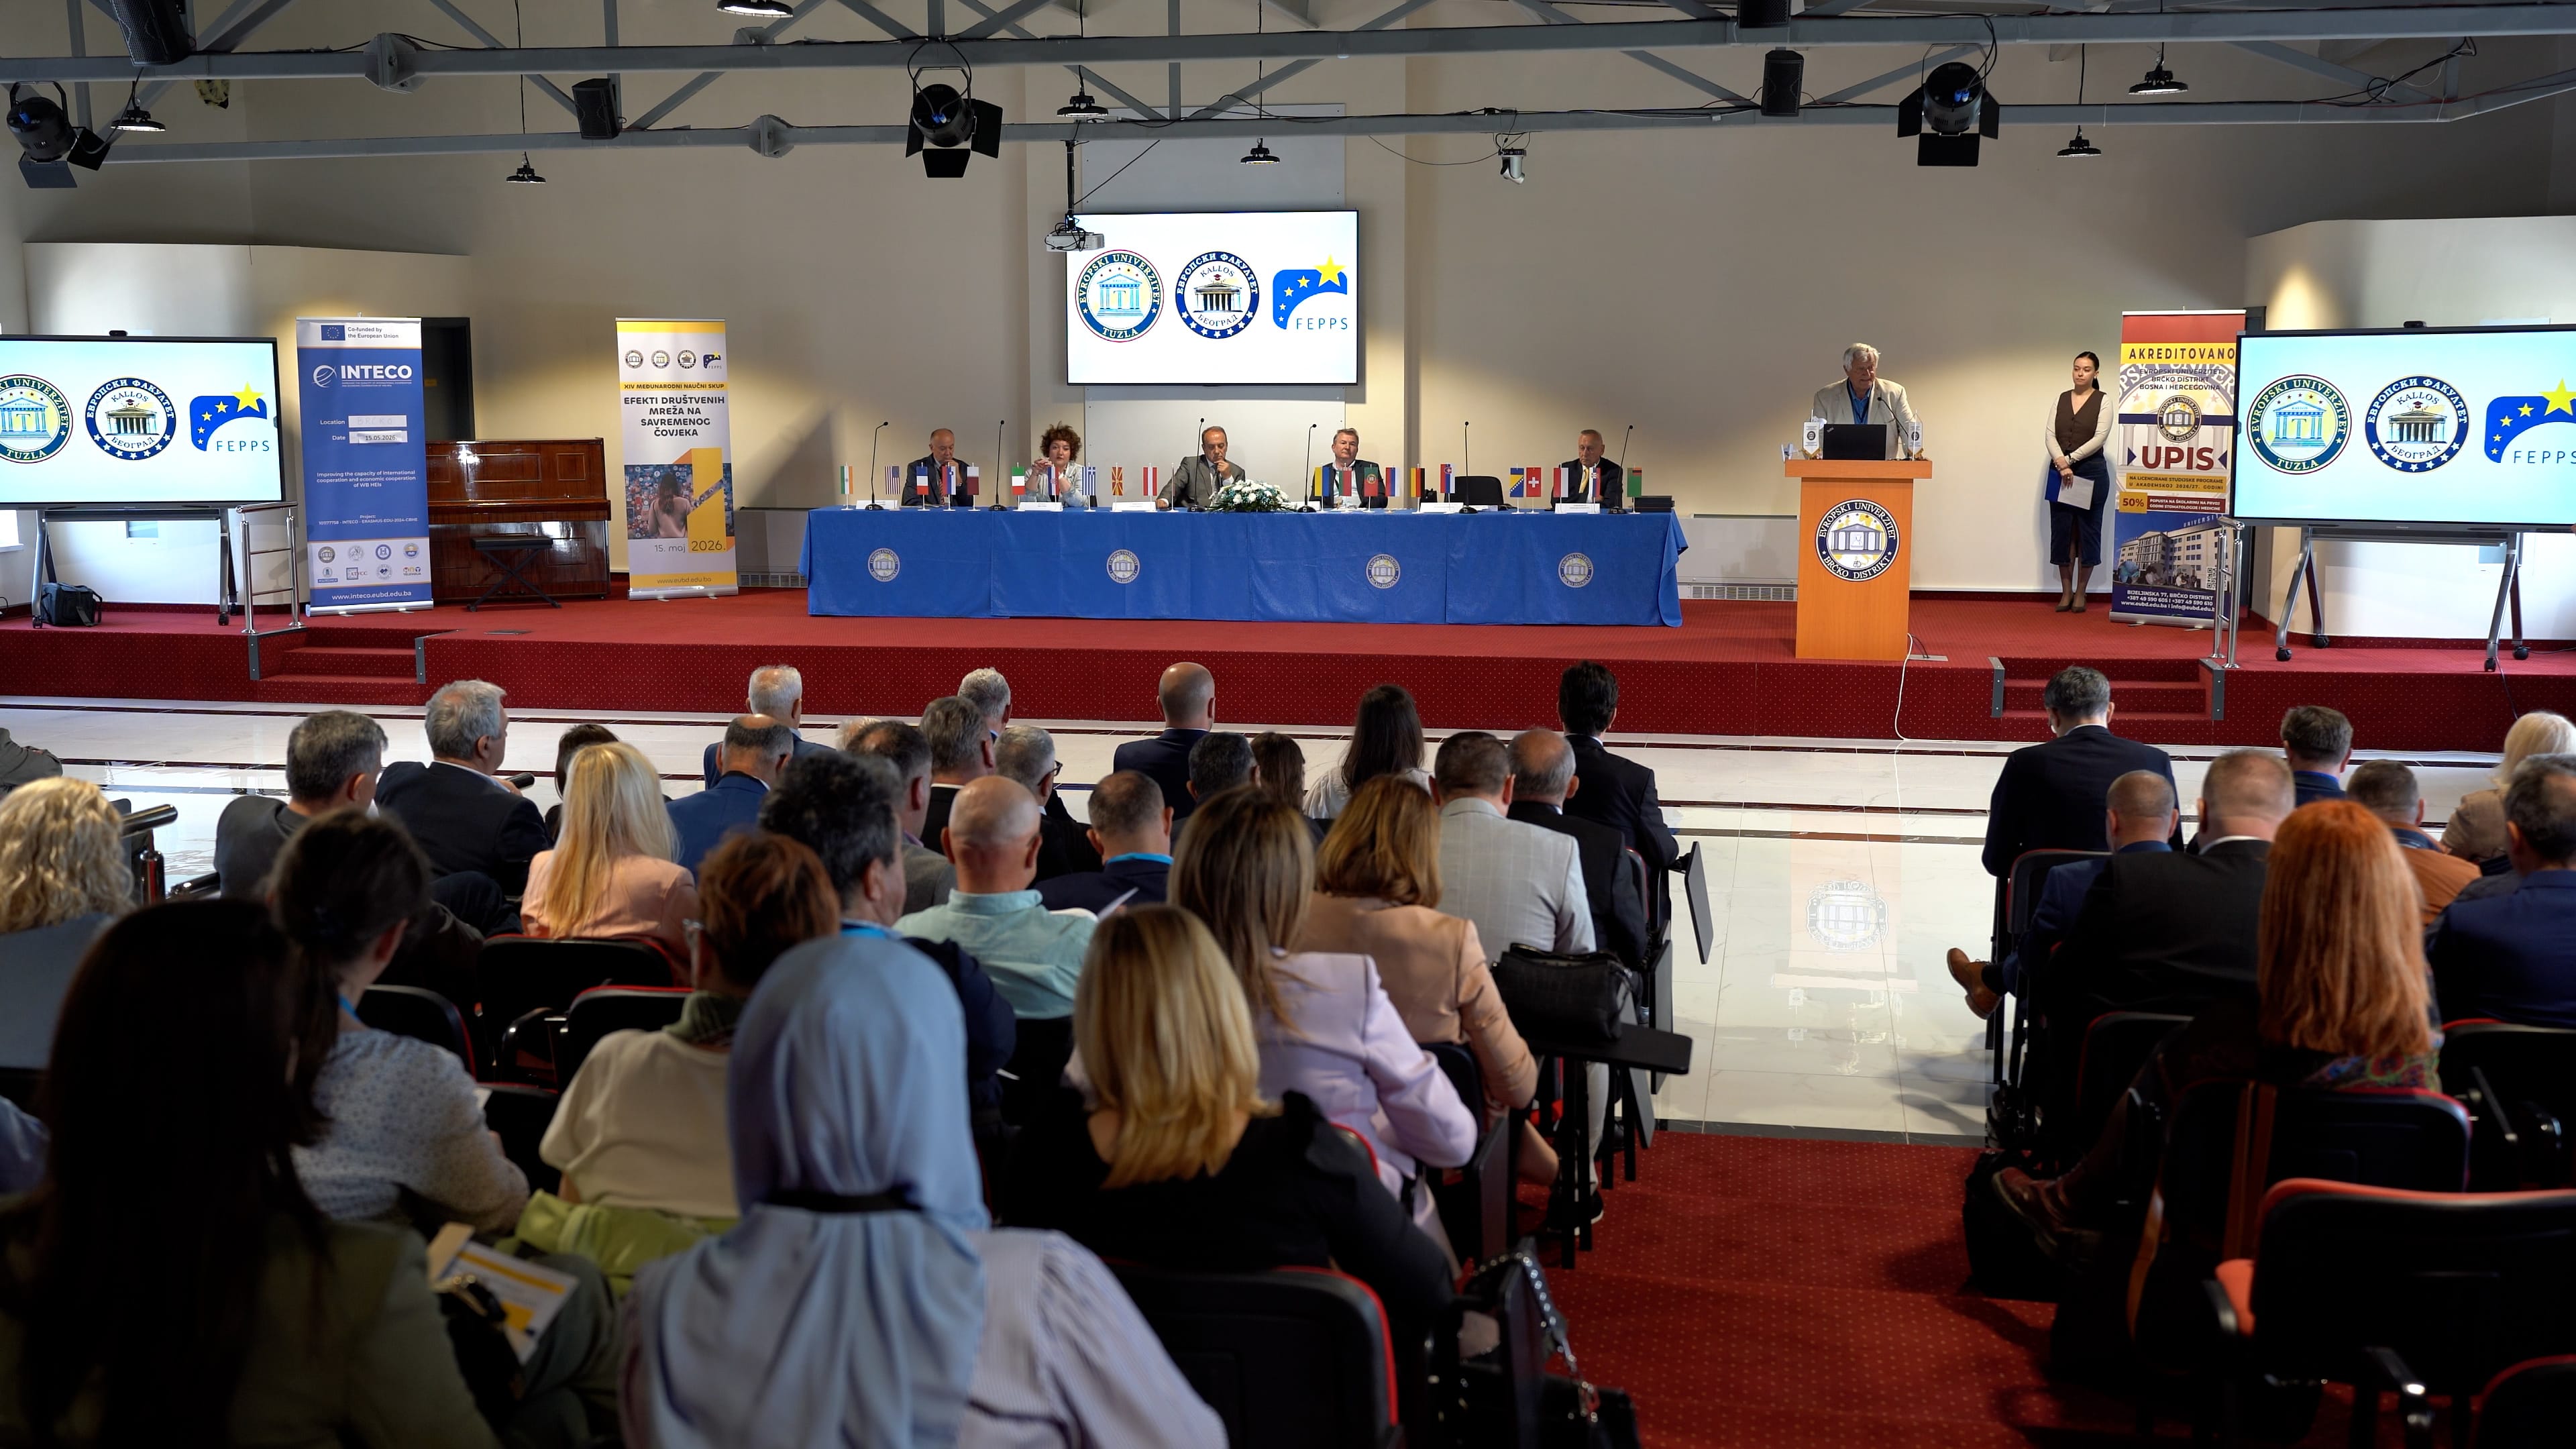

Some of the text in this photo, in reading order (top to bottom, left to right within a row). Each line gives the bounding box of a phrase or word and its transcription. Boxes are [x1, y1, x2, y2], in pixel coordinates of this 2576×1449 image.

[1177, 252, 1258, 294] ЕВРОПСКИ ФАКУЛТЕТ
[1200, 265, 1235, 278] KALLOS
[1079, 254, 1160, 305] EVROPSKI UNIVERZITET
[1197, 313, 1238, 327] БЕОГРАД
[1296, 317, 1348, 329] FEPPS
[1102, 327, 1139, 339] TUZLA
[2129, 347, 2235, 360] AKREDITOVANO
[341, 364, 413, 380] INTECO
[87, 379, 175, 419] ЕВРОПСКИ ФАКУЛТЕТ
[111, 391, 149, 402] KALLOS
[661, 394, 724, 405] DRUŠTVENIH
[2367, 378, 2467, 424] ЕВРОПСКИ ФАКУЛТЕТ
[2396, 391, 2440, 405] KALLOS
[13, 379, 68, 428] UNIVERZITET
[649, 405, 685, 415] MREŽA
[2251, 379, 2347, 435] EVROPSKI UNIVERZITET
[641, 418, 710, 426] SAVREMENOG
[654, 427, 698, 437] ČOVJEKA
[111, 436, 156, 449] БЕОГРАД
[216, 440, 270, 452] FEPPS
[6, 449, 47, 460] TUZLA
[2142, 445, 2214, 471] UPIS
[2391, 445, 2442, 459] БЕОГРАД
[2276, 458, 2320, 470] TUZLA
[2123, 498, 2145, 507] 50%
[1819, 502, 1896, 540] EVROPSKI UNIVERZITET
[655, 540, 726, 553] 15. maj 2026.
[1823, 555, 1891, 580] BRČKO DISTRIKT
[331, 590, 412, 600] www.inteco.eubd.edu.ba
[2121, 600, 2167, 608] www.eubd.edu.ba
